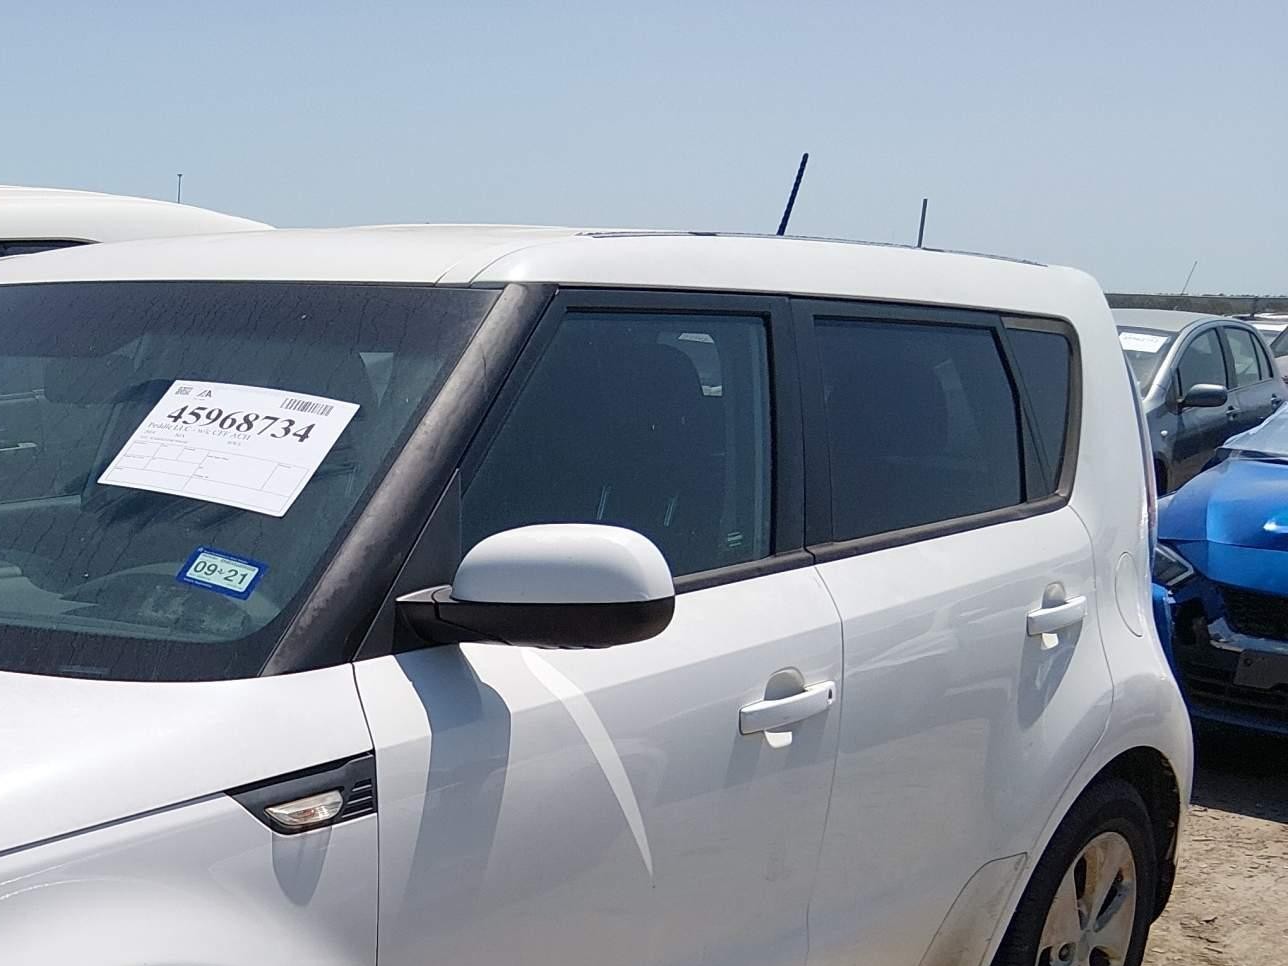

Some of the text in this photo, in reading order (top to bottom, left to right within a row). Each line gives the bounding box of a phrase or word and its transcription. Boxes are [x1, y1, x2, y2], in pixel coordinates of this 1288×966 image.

[166, 403, 317, 443] 45968734
[193, 560, 218, 576] 09
[223, 568, 249, 585] 21
